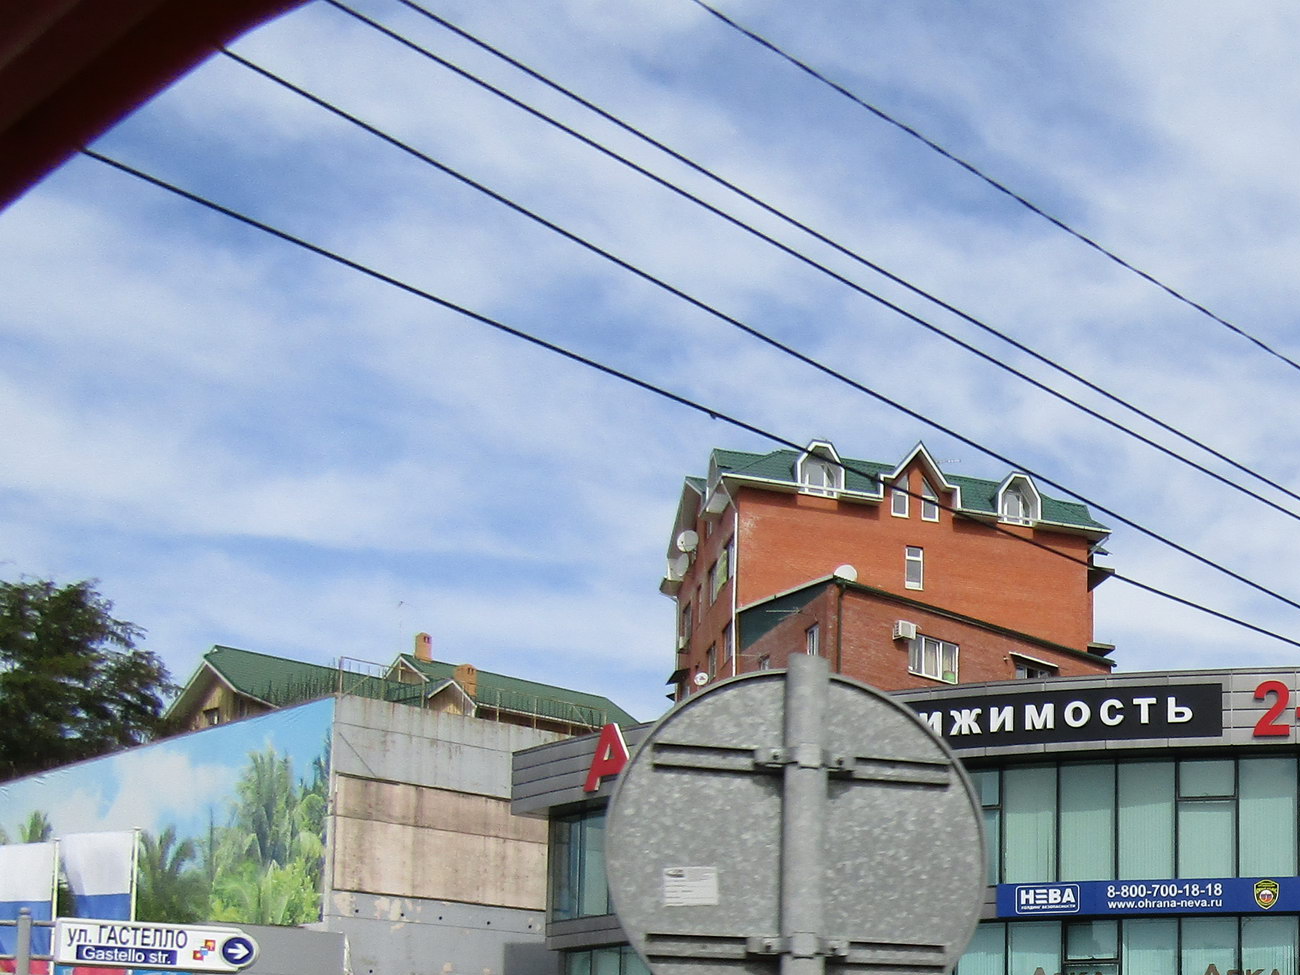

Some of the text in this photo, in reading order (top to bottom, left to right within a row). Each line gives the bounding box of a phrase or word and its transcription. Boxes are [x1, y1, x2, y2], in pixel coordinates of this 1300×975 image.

[1020, 888, 1076, 905] НЕВА
[1107, 883, 1223, 898] 8-800-700-18-18
[1107, 898, 1223, 909] www.ohrana-neva.ru
[67, 925, 188, 949] ул. ГАСТЕЛЛО
[82, 946, 171, 965] Gastello str.
